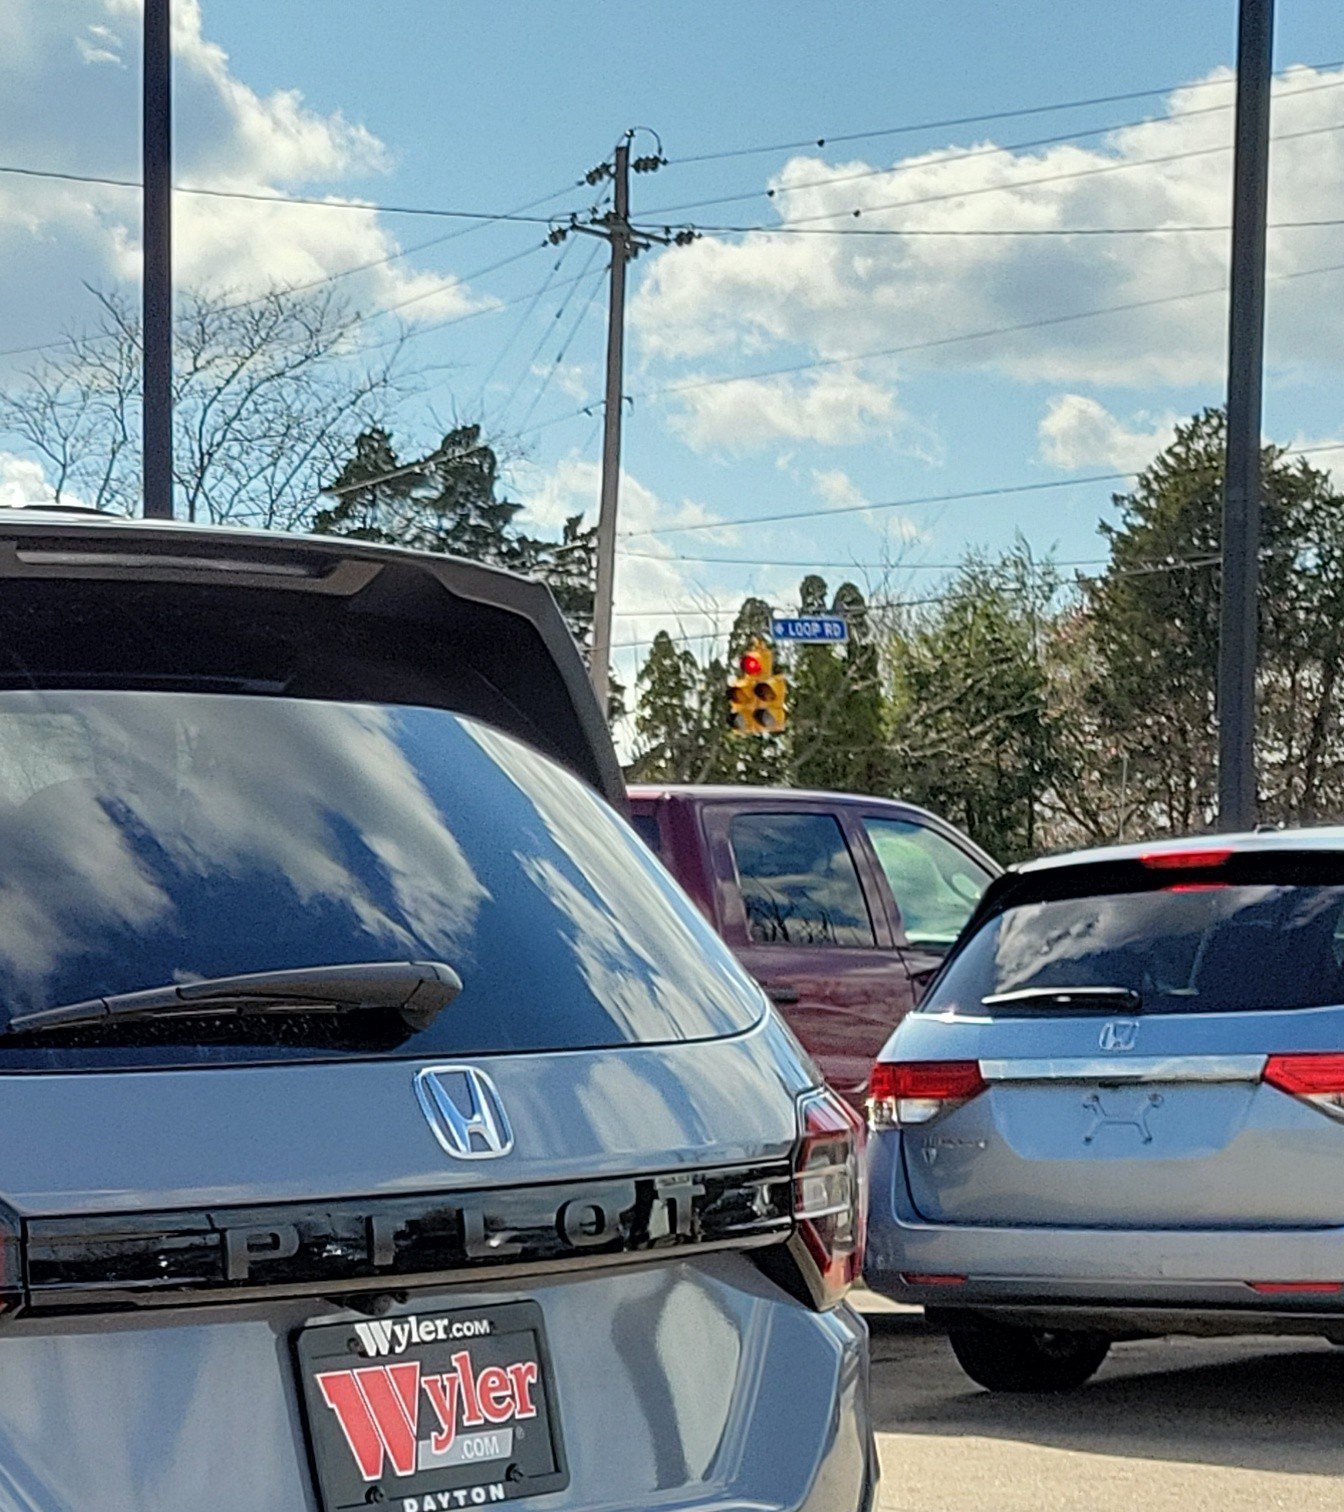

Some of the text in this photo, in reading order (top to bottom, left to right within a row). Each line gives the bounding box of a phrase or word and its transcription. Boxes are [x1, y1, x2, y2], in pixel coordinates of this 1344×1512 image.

[787, 622, 842, 637] LOOP RD
[223, 1182, 708, 1281] PILOT
[314, 1350, 538, 1482] Wyler
